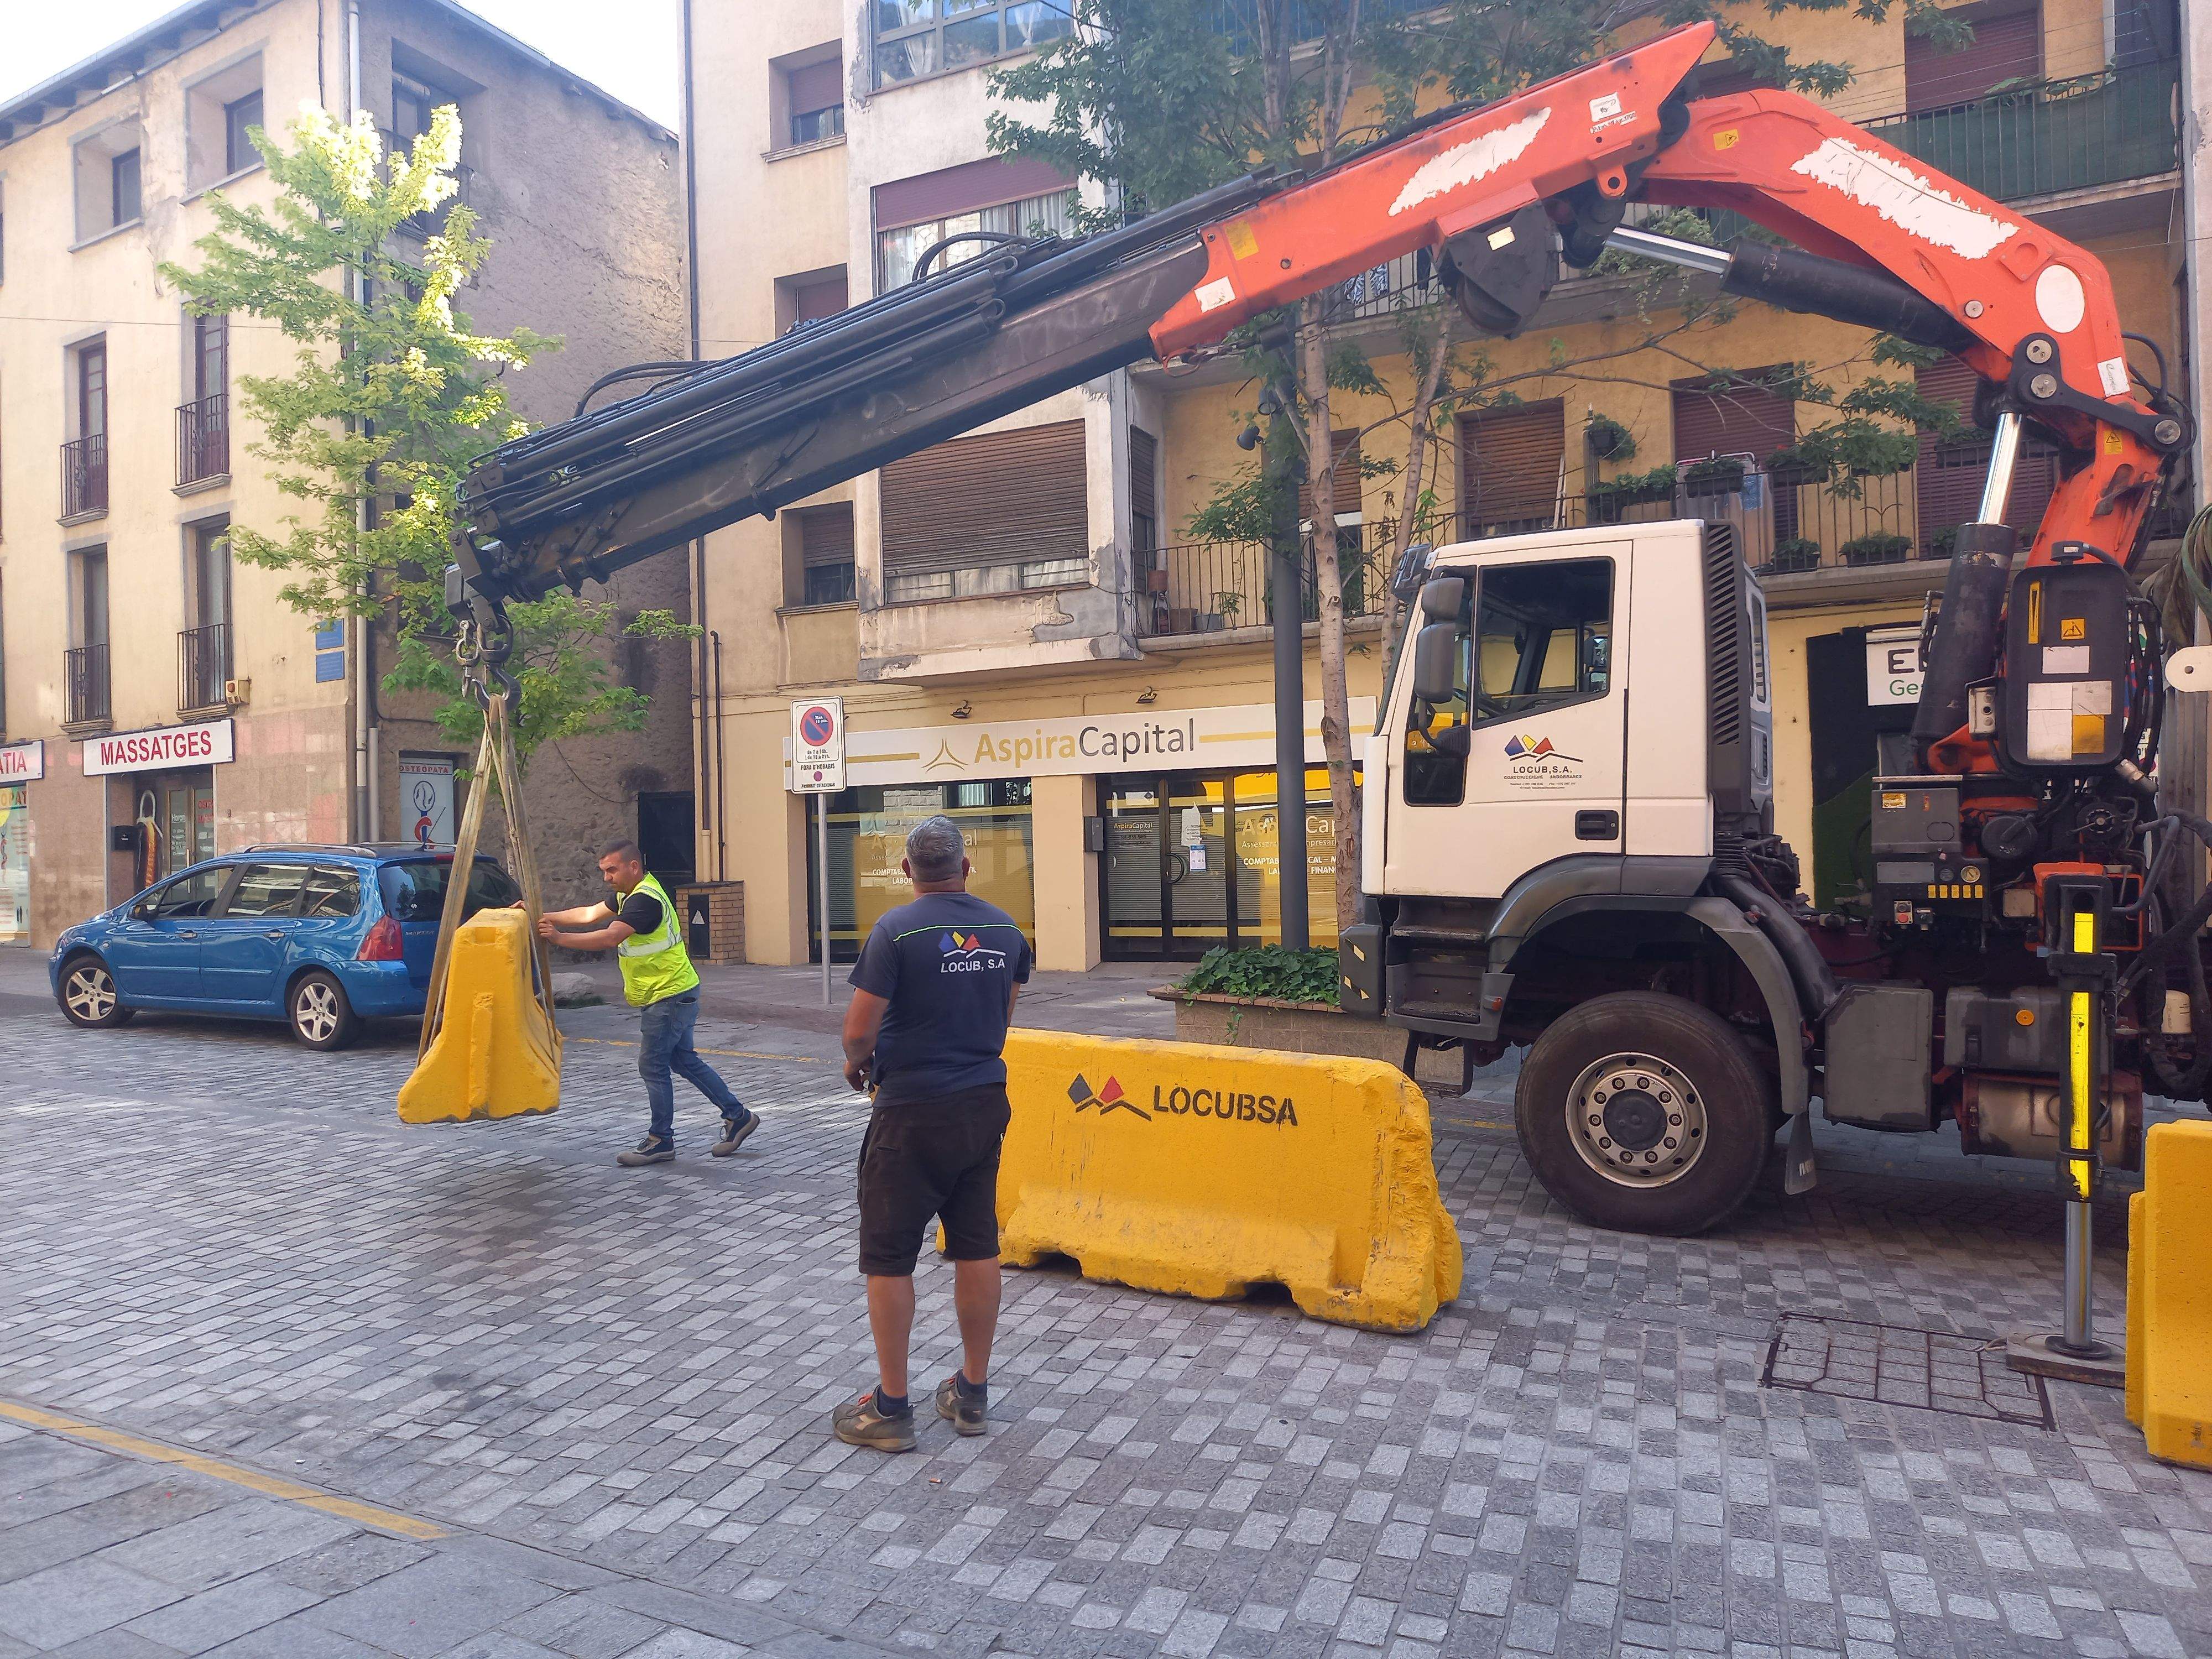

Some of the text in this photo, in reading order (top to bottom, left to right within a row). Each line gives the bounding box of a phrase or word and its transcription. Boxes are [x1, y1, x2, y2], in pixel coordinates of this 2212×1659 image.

[101, 731, 211, 765] MASSATGES
[974, 718, 1193, 768] AspiraCapital
[1114, 822, 1152, 830] AspiraCapital
[941, 958, 1005, 973] LOCUB, S.A
[1154, 1084, 1298, 1126] LOCUBSA
